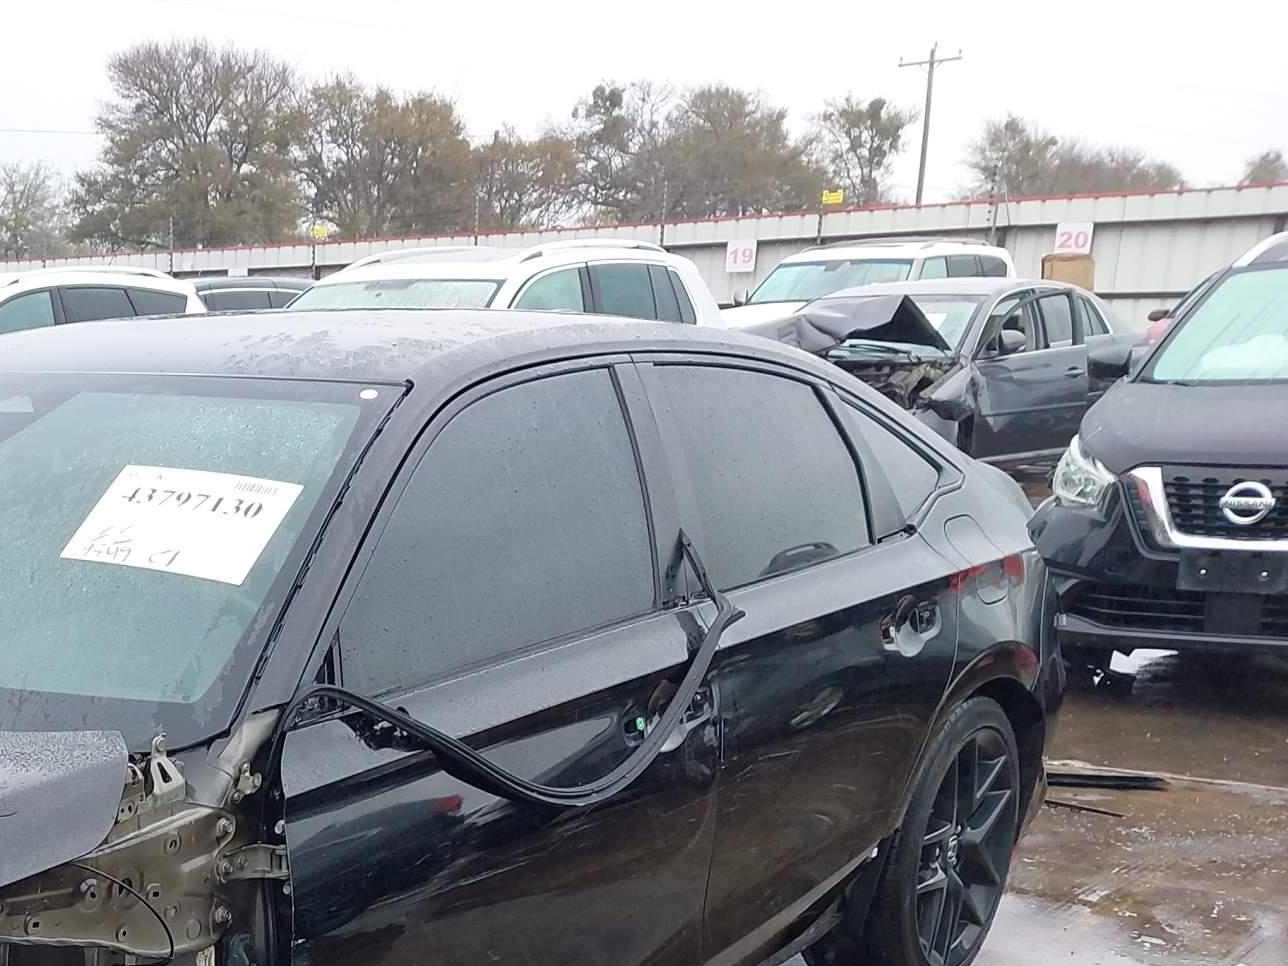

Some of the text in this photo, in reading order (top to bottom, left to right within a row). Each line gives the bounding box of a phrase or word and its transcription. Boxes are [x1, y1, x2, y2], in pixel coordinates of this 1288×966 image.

[1057, 231, 1089, 249] 20
[729, 247, 753, 265] 19
[122, 486, 264, 519] 43797130
[1223, 498, 1274, 508] NISSAN
